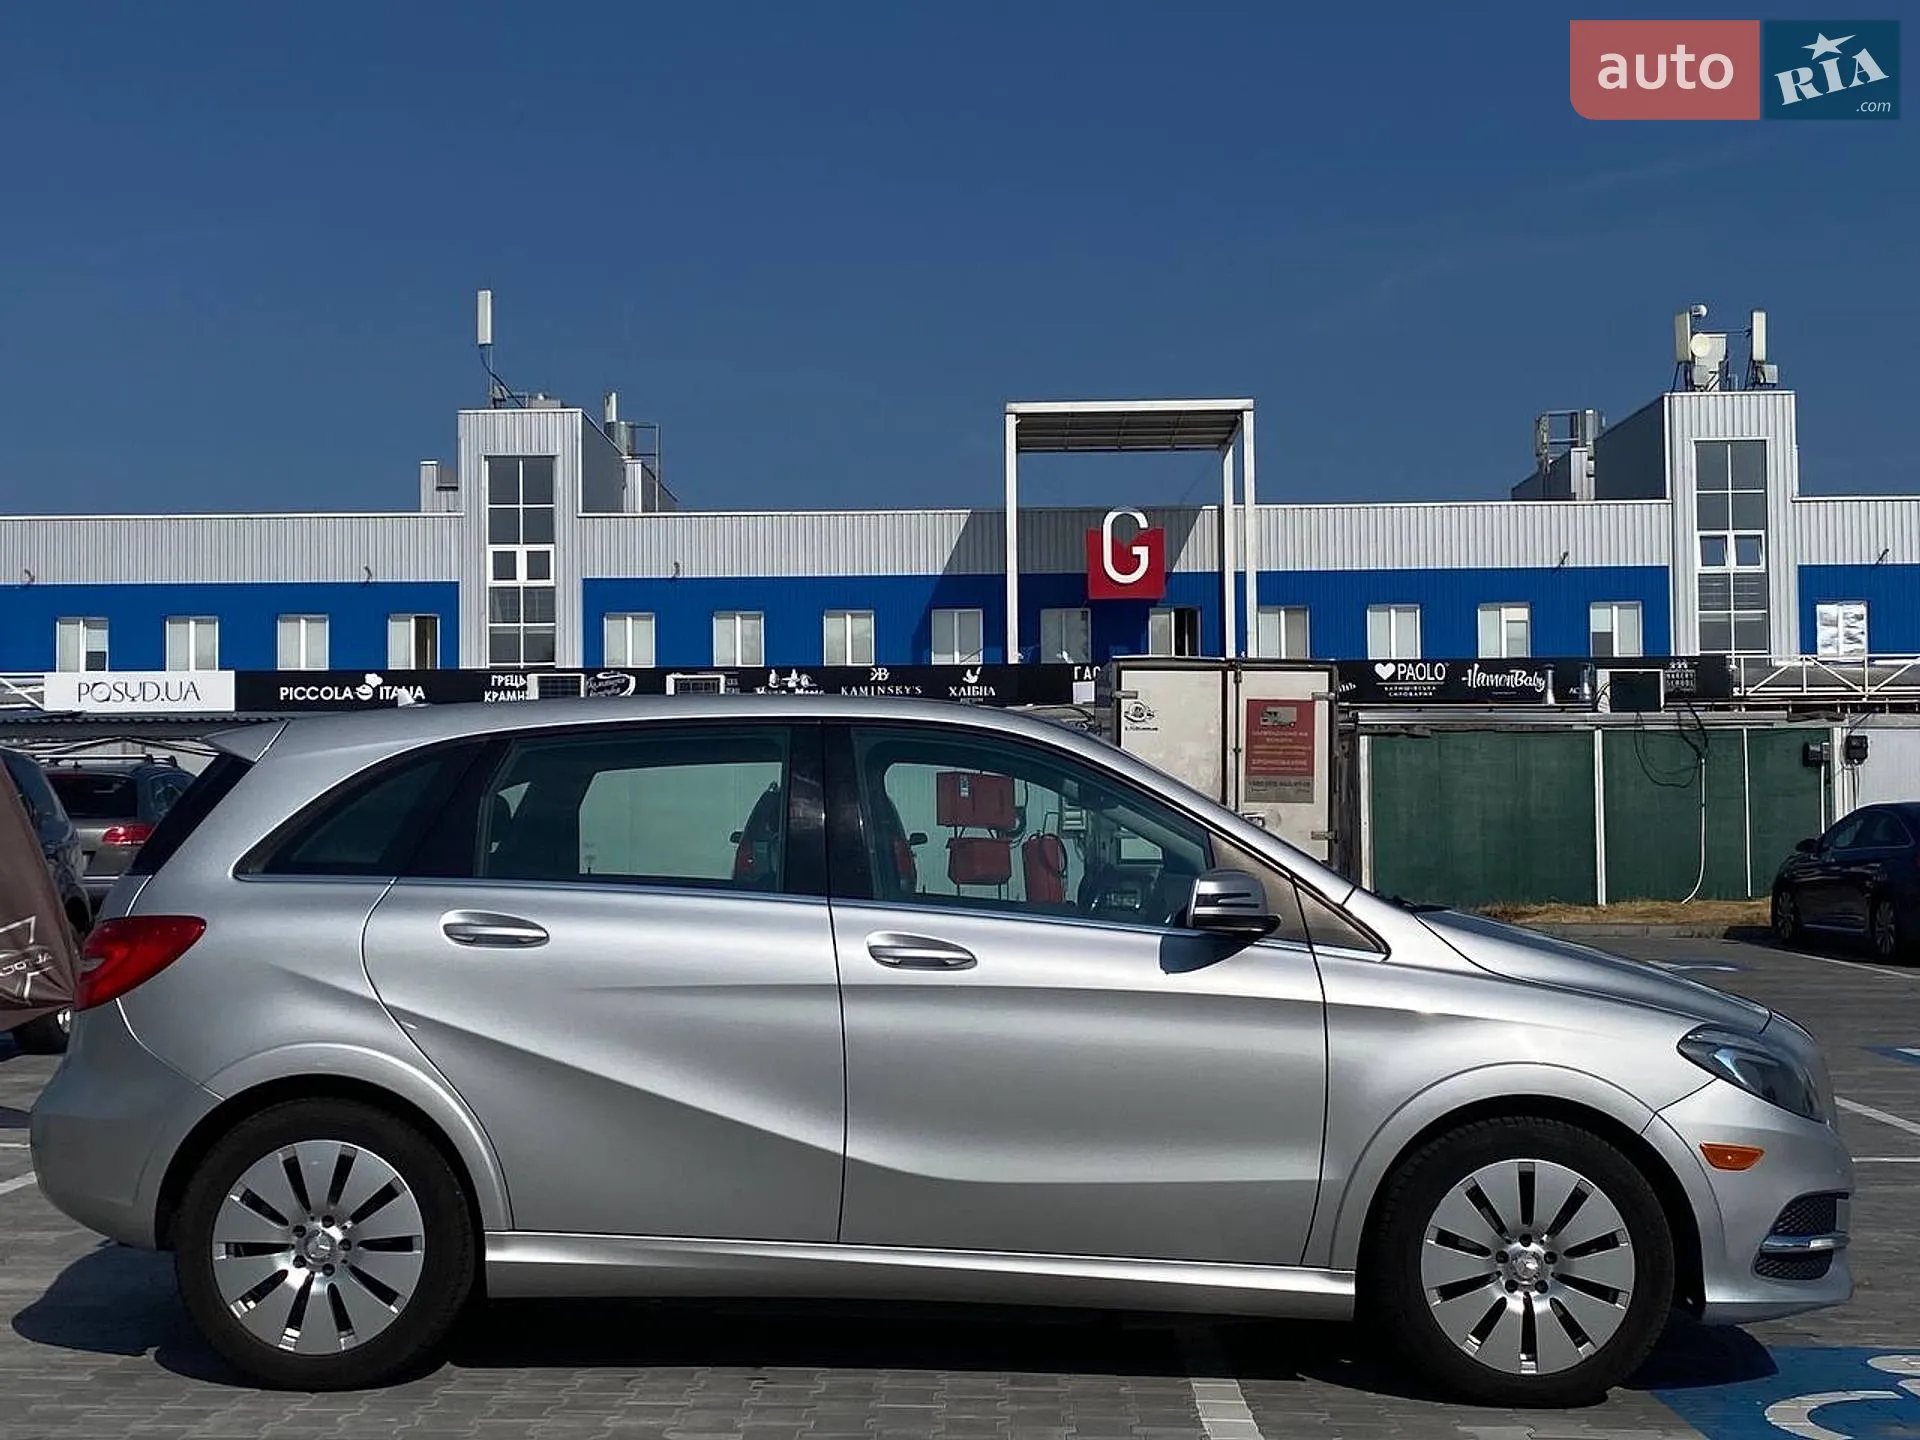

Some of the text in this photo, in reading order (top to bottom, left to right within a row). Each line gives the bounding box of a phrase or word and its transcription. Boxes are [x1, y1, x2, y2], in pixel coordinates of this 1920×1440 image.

[1102, 506, 1149, 584] G
[1397, 662, 1446, 681] PAOLO
[491, 674, 527, 689] ГРЕЦЬ
[279, 686, 426, 700] PICCOLA ITAIA
[484, 689, 526, 702] КРАМН
[841, 685, 923, 697] KAMINSKY'S
